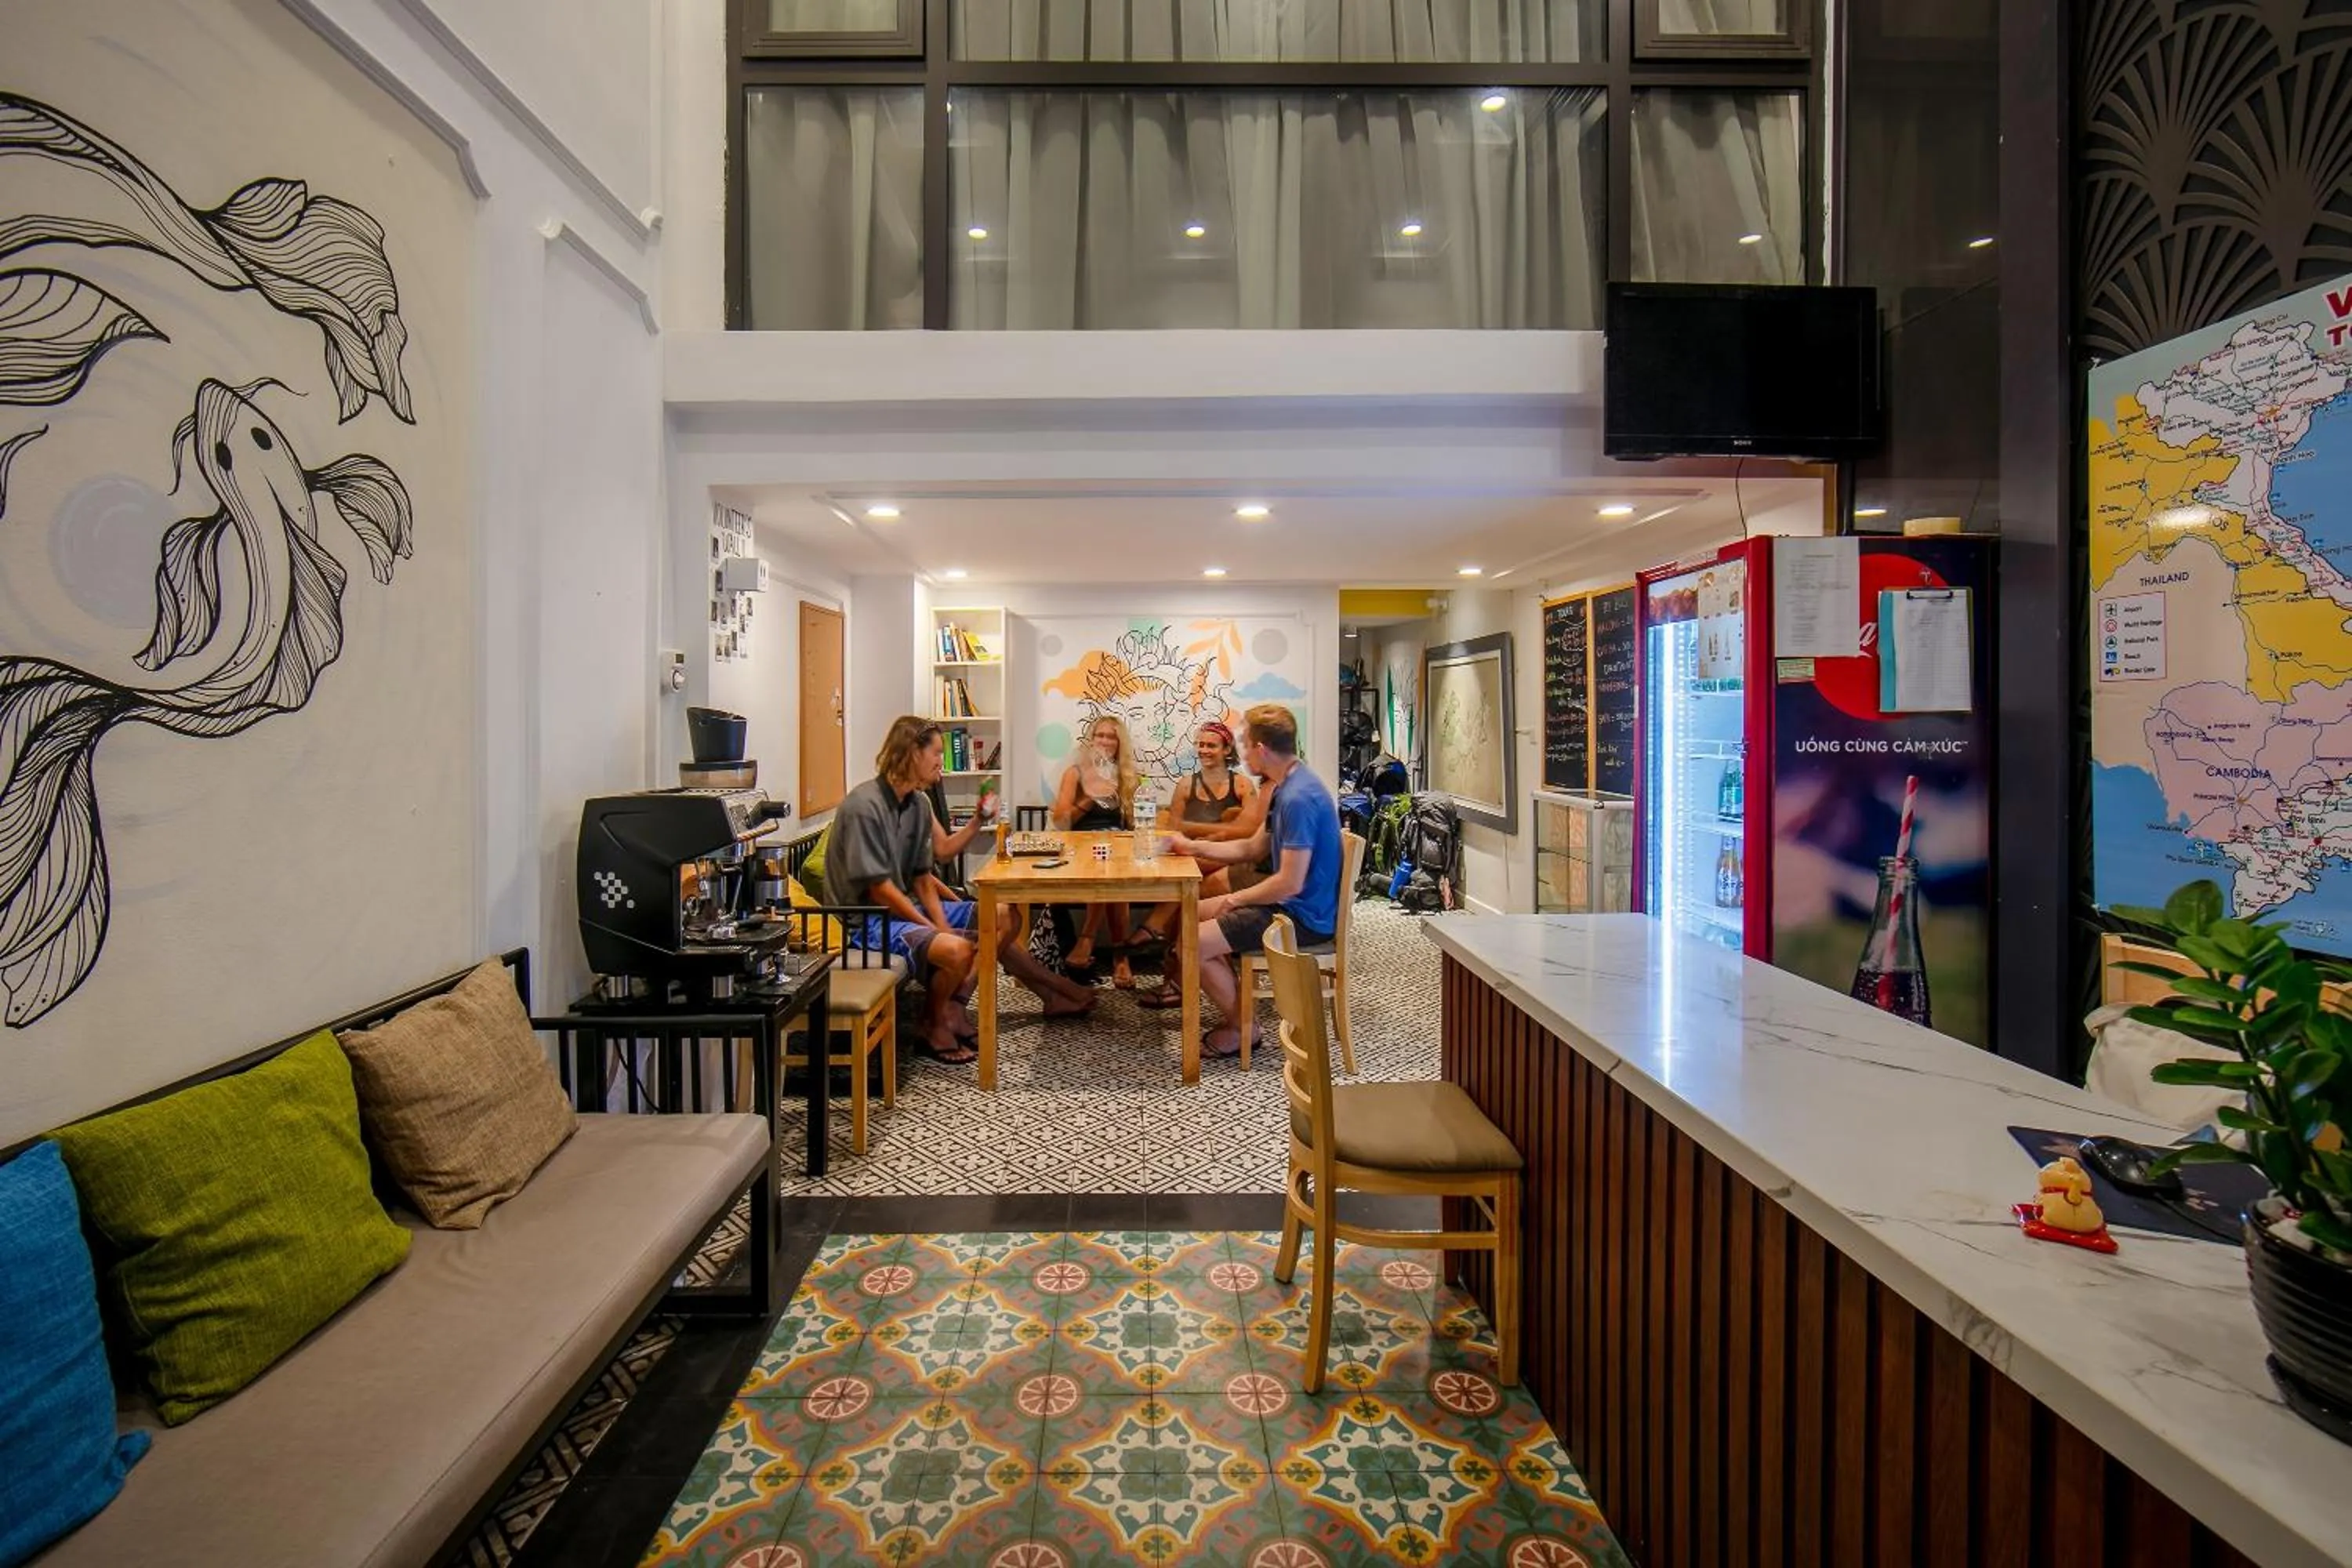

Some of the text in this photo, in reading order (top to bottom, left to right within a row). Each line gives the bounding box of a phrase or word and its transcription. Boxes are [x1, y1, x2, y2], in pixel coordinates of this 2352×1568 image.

[2140, 572, 2190, 587] THAILAND
[1795, 735, 1840, 753] UỐNG
[1845, 738, 1889, 753] CÙNG
[2205, 766, 2272, 779] CAMBODIA
